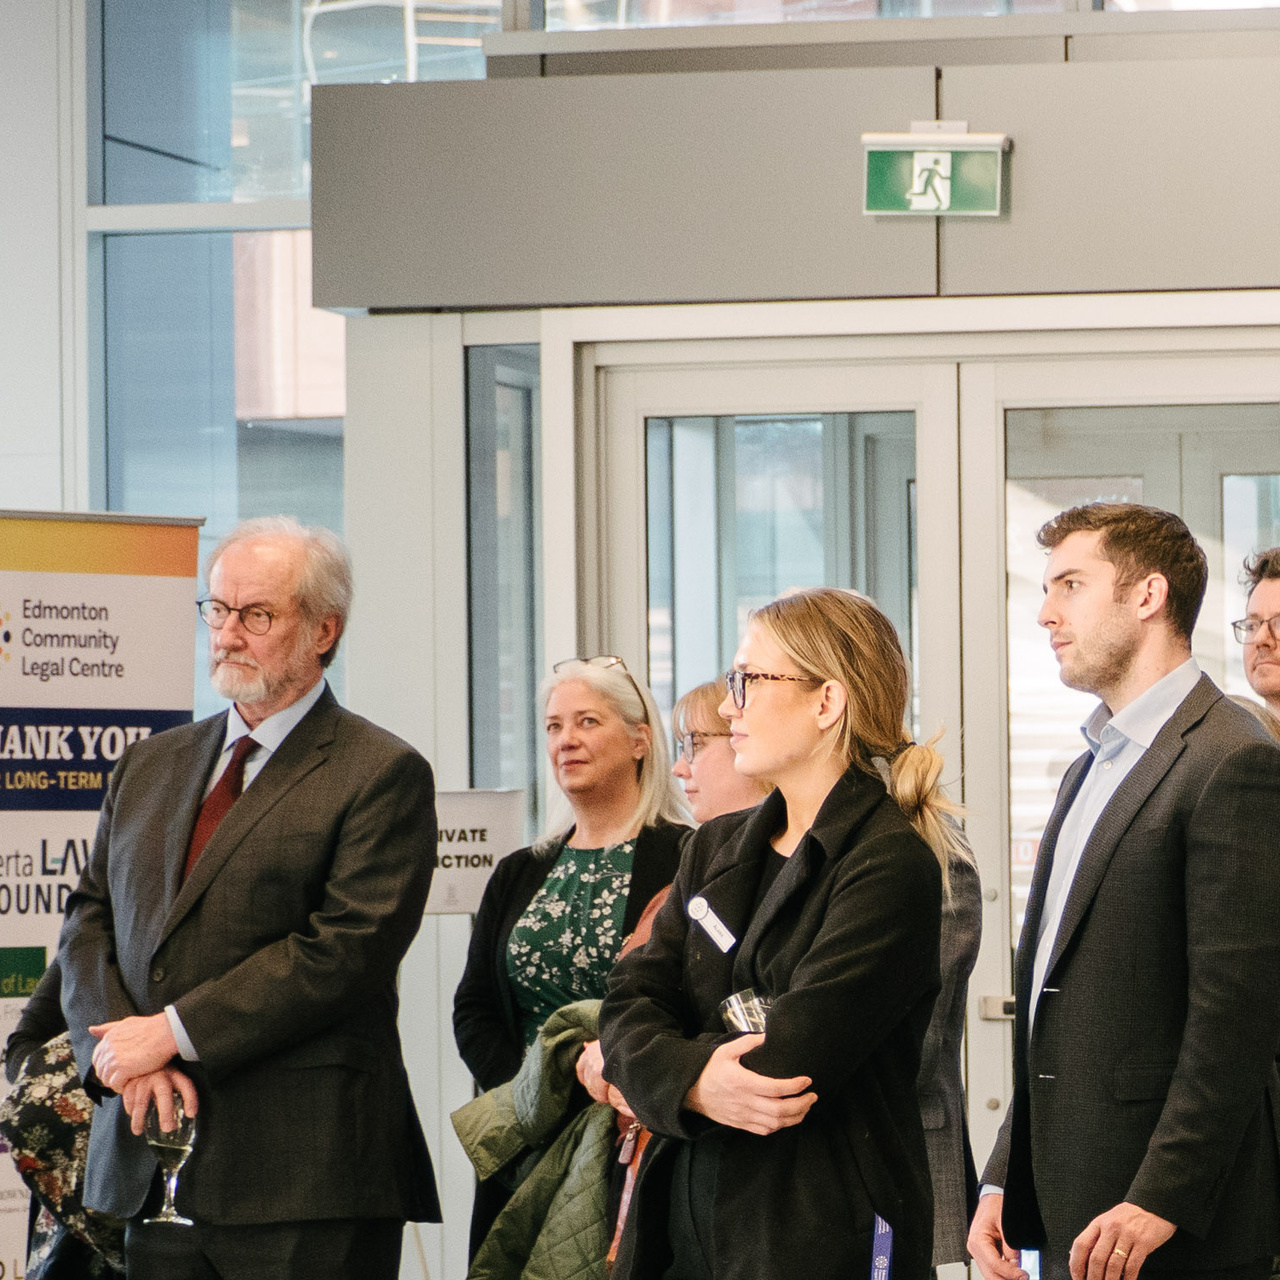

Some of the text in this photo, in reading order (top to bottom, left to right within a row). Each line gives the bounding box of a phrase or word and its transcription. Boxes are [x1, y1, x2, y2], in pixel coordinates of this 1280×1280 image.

[23, 600, 108, 620] Edmonton
[22, 628, 119, 654] Community
[22, 657, 124, 682] Legal Centre
[0, 725, 74, 760] ANK
[5, 771, 102, 790] LONG-TERM
[438, 829, 488, 843] IVATE
[436, 854, 493, 869] CTION
